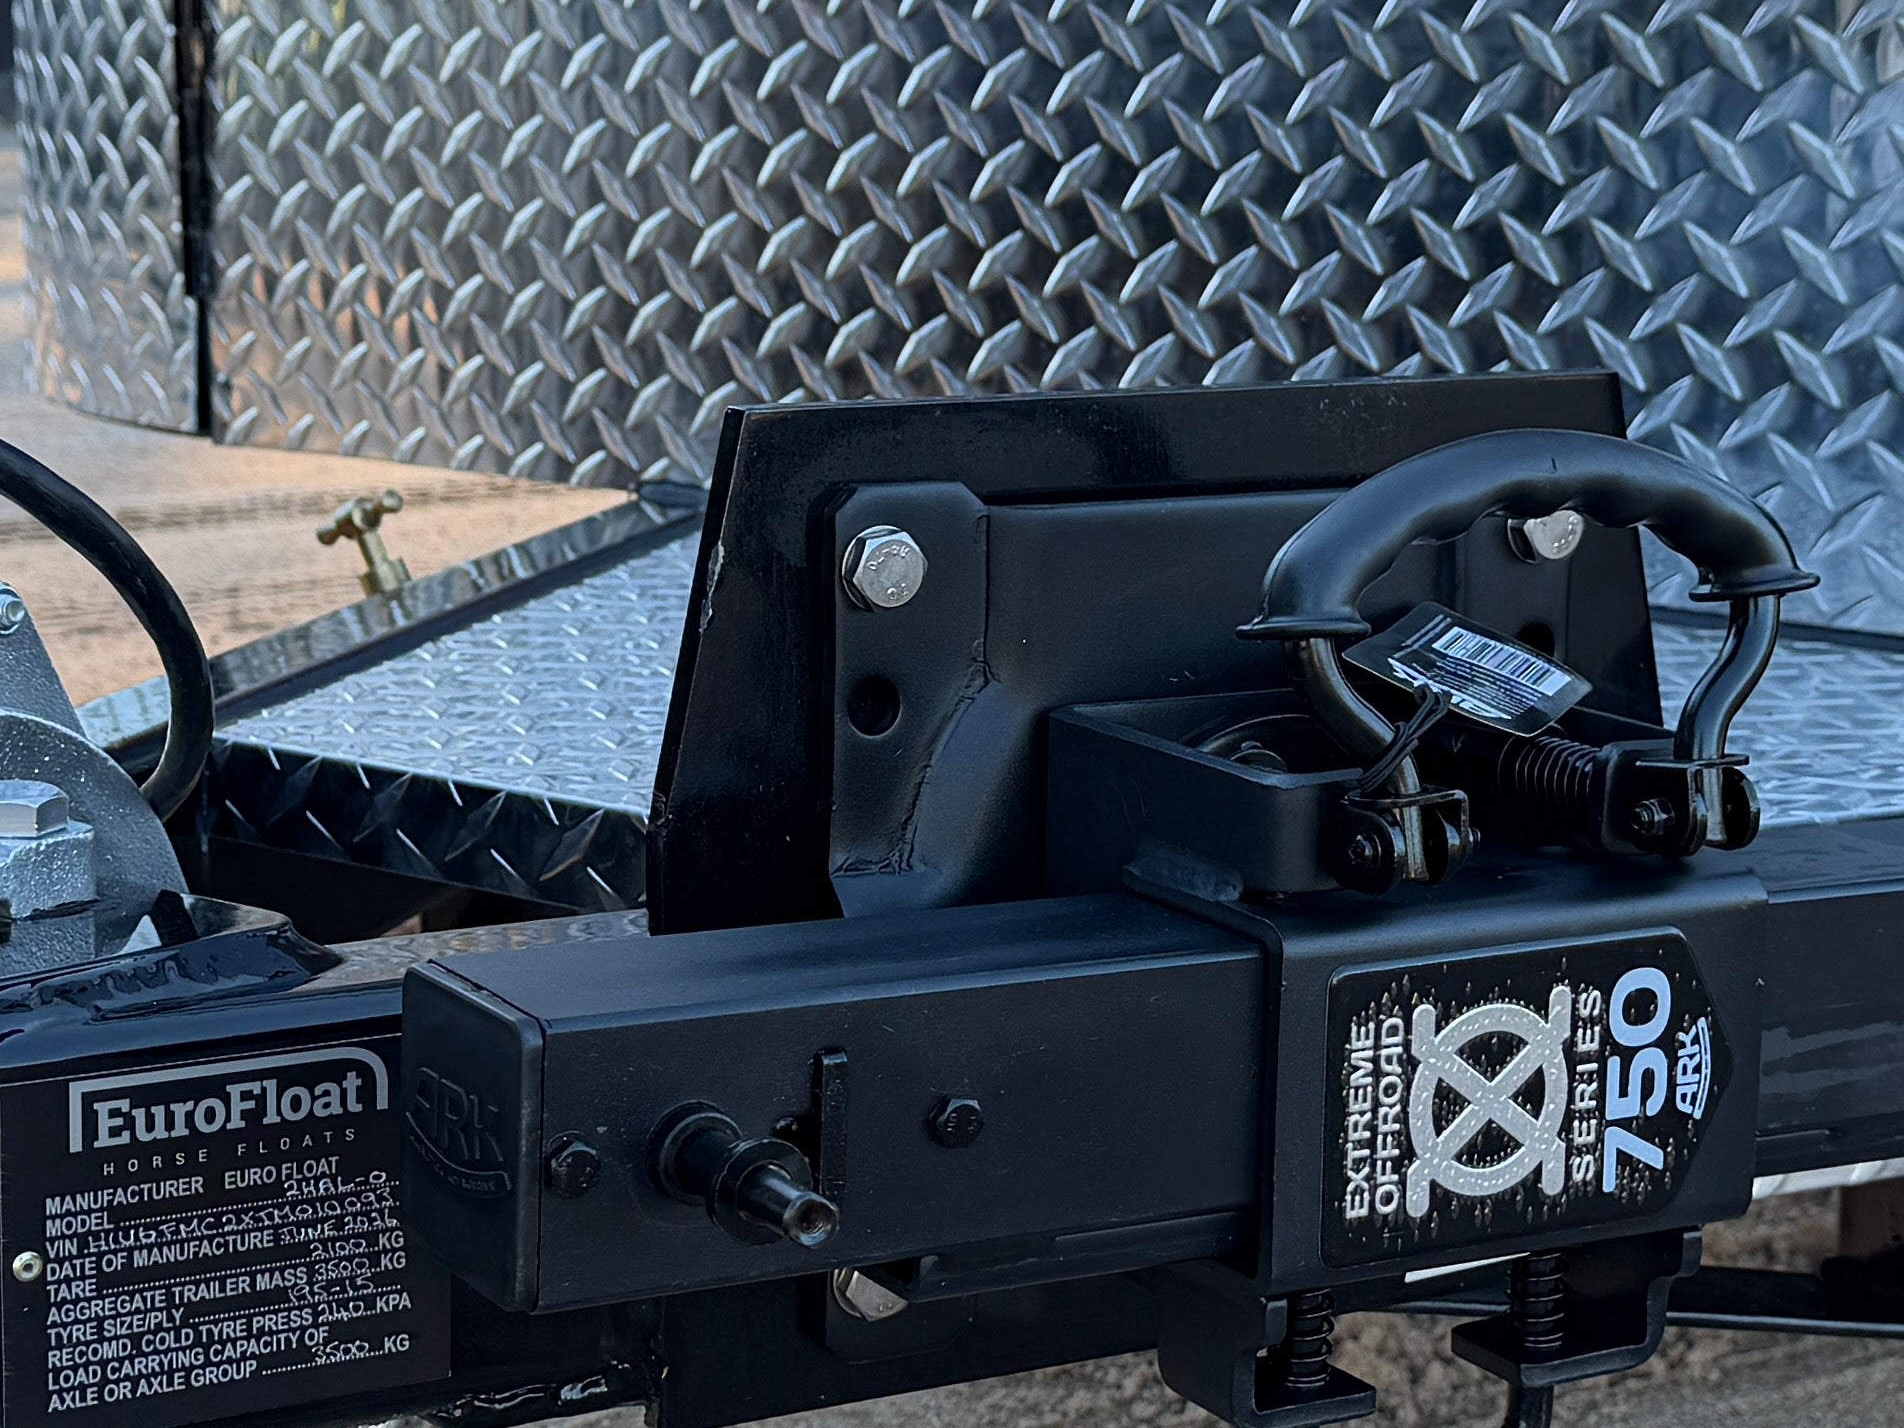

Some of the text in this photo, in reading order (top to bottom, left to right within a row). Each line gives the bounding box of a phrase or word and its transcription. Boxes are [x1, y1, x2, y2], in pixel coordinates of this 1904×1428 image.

[1570, 989, 1602, 1182] SERIES
[1602, 967, 1672, 1193] 750
[1676, 1023, 1704, 1116] ARK
[93, 1071, 364, 1149] EuroFloat
[1344, 1021, 1376, 1220] EXTREME
[1375, 1016, 1405, 1215] OFFROAD
[46, 1155, 340, 1216] MANUFACTURER EURO FLOAT
[103, 1128, 356, 1176] HORSE FLOATS
[46, 1211, 115, 1238] MODEL
[46, 1237, 78, 1260] VIN
[47, 1257, 97, 1281] DATE
[101, 1252, 128, 1273] OF
[133, 1229, 275, 1268] MANUFACTURE
[46, 1278, 97, 1303] TARE
[378, 1230, 405, 1250] KG
[47, 1289, 167, 1325] AGGREGATE
[172, 1275, 251, 1305] TRAILER
[256, 1266, 308, 1292] MASS
[380, 1250, 406, 1271] KG
[47, 1322, 98, 1347] TYRE
[103, 1307, 185, 1338] SIZE/PLY
[48, 1338, 137, 1369] RECOMD.
[142, 1328, 194, 1352] COLD
[199, 1318, 247, 1343] TYRE
[252, 1308, 313, 1334] PRESS
[376, 1292, 412, 1314] KPA
[48, 1325, 330, 1391] LOAD CARRYING CAPACITY OF
[48, 1387, 99, 1413] AXLE
[104, 1381, 132, 1402] OR
[136, 1372, 186, 1397] AXLE
[190, 1360, 257, 1387] GROUP
[384, 1333, 410, 1354] KG
